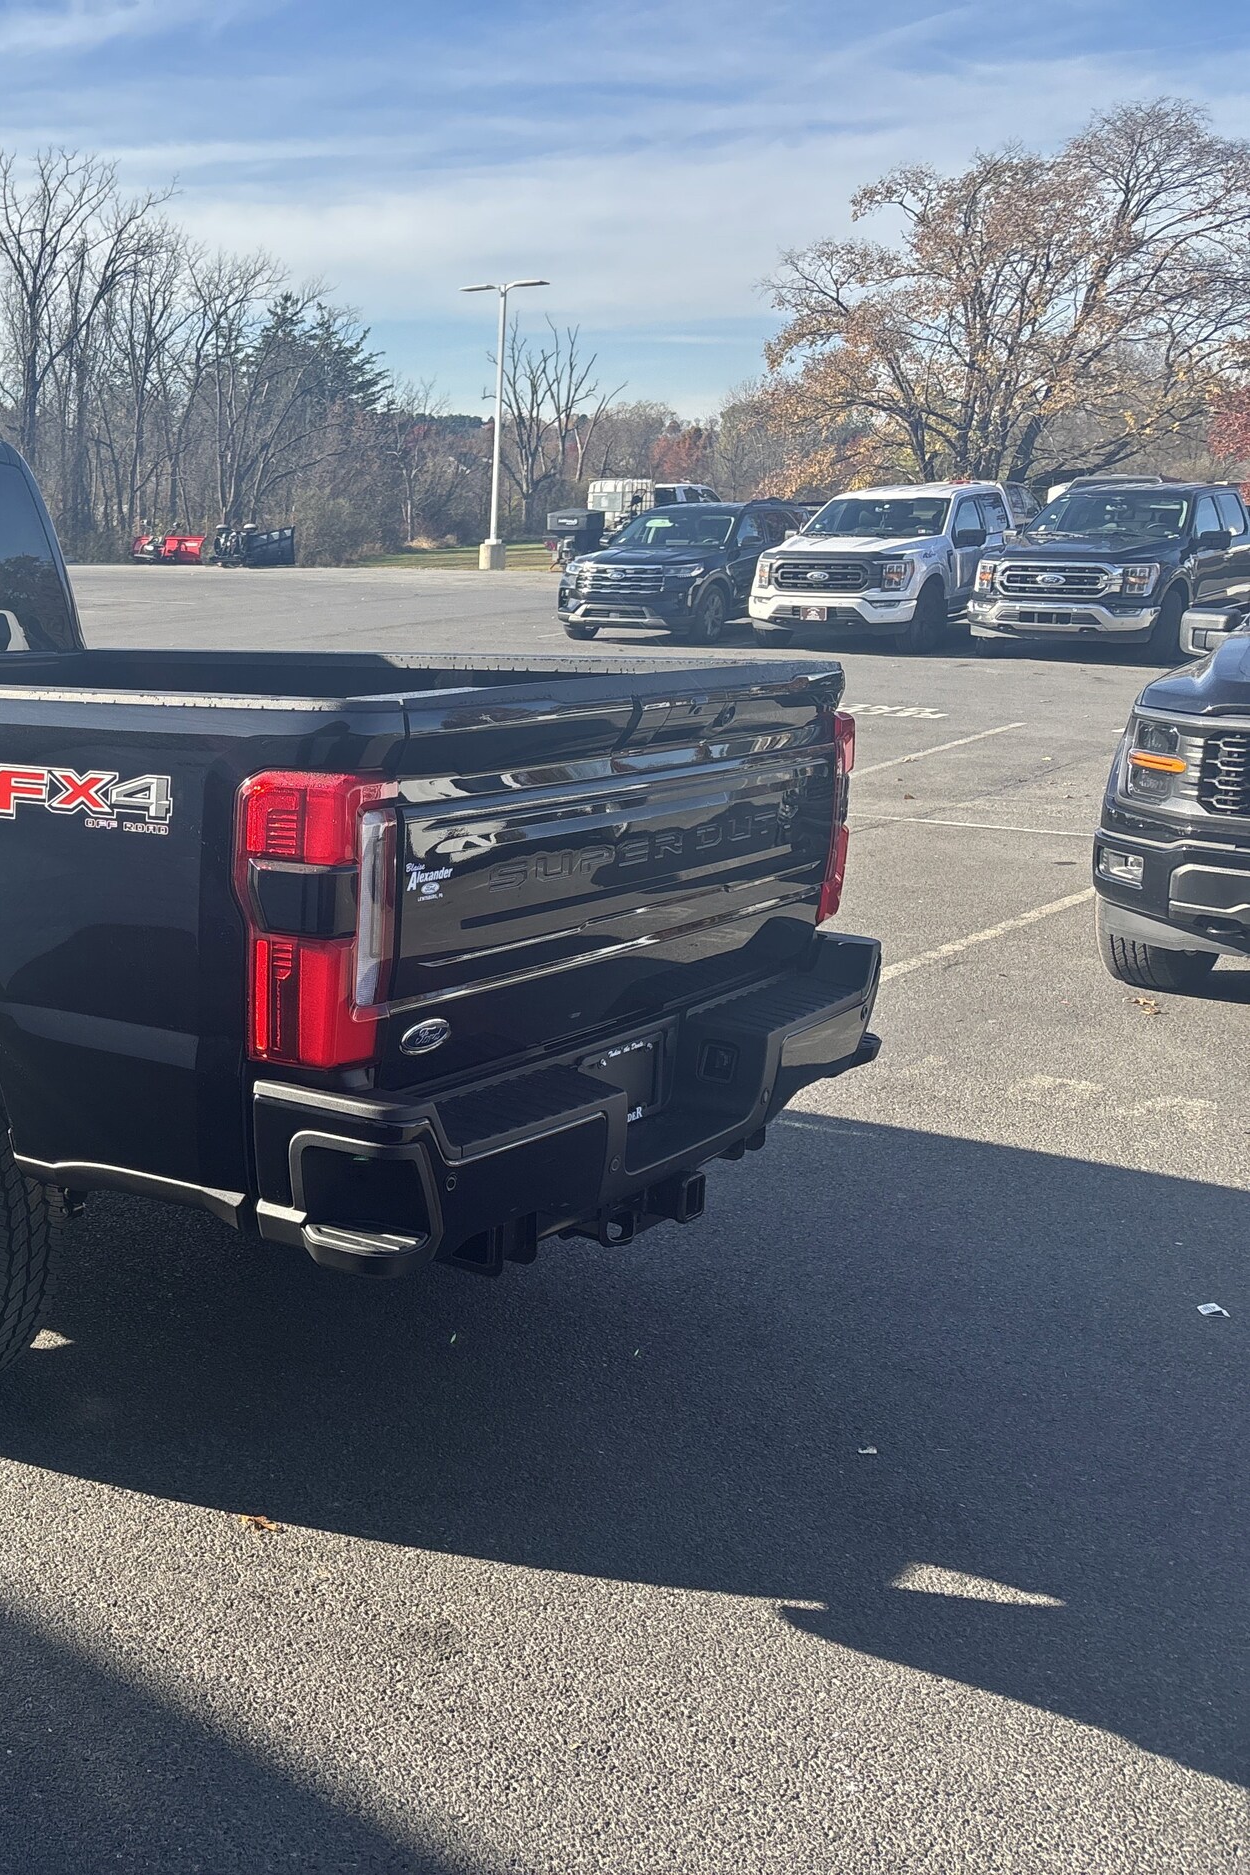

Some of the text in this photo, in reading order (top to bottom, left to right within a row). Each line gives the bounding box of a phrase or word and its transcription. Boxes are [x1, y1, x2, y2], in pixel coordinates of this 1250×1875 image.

[85, 818, 169, 835] OFF ROAD
[489, 832, 683, 893] SUPER
[407, 867, 453, 891] Alexander
